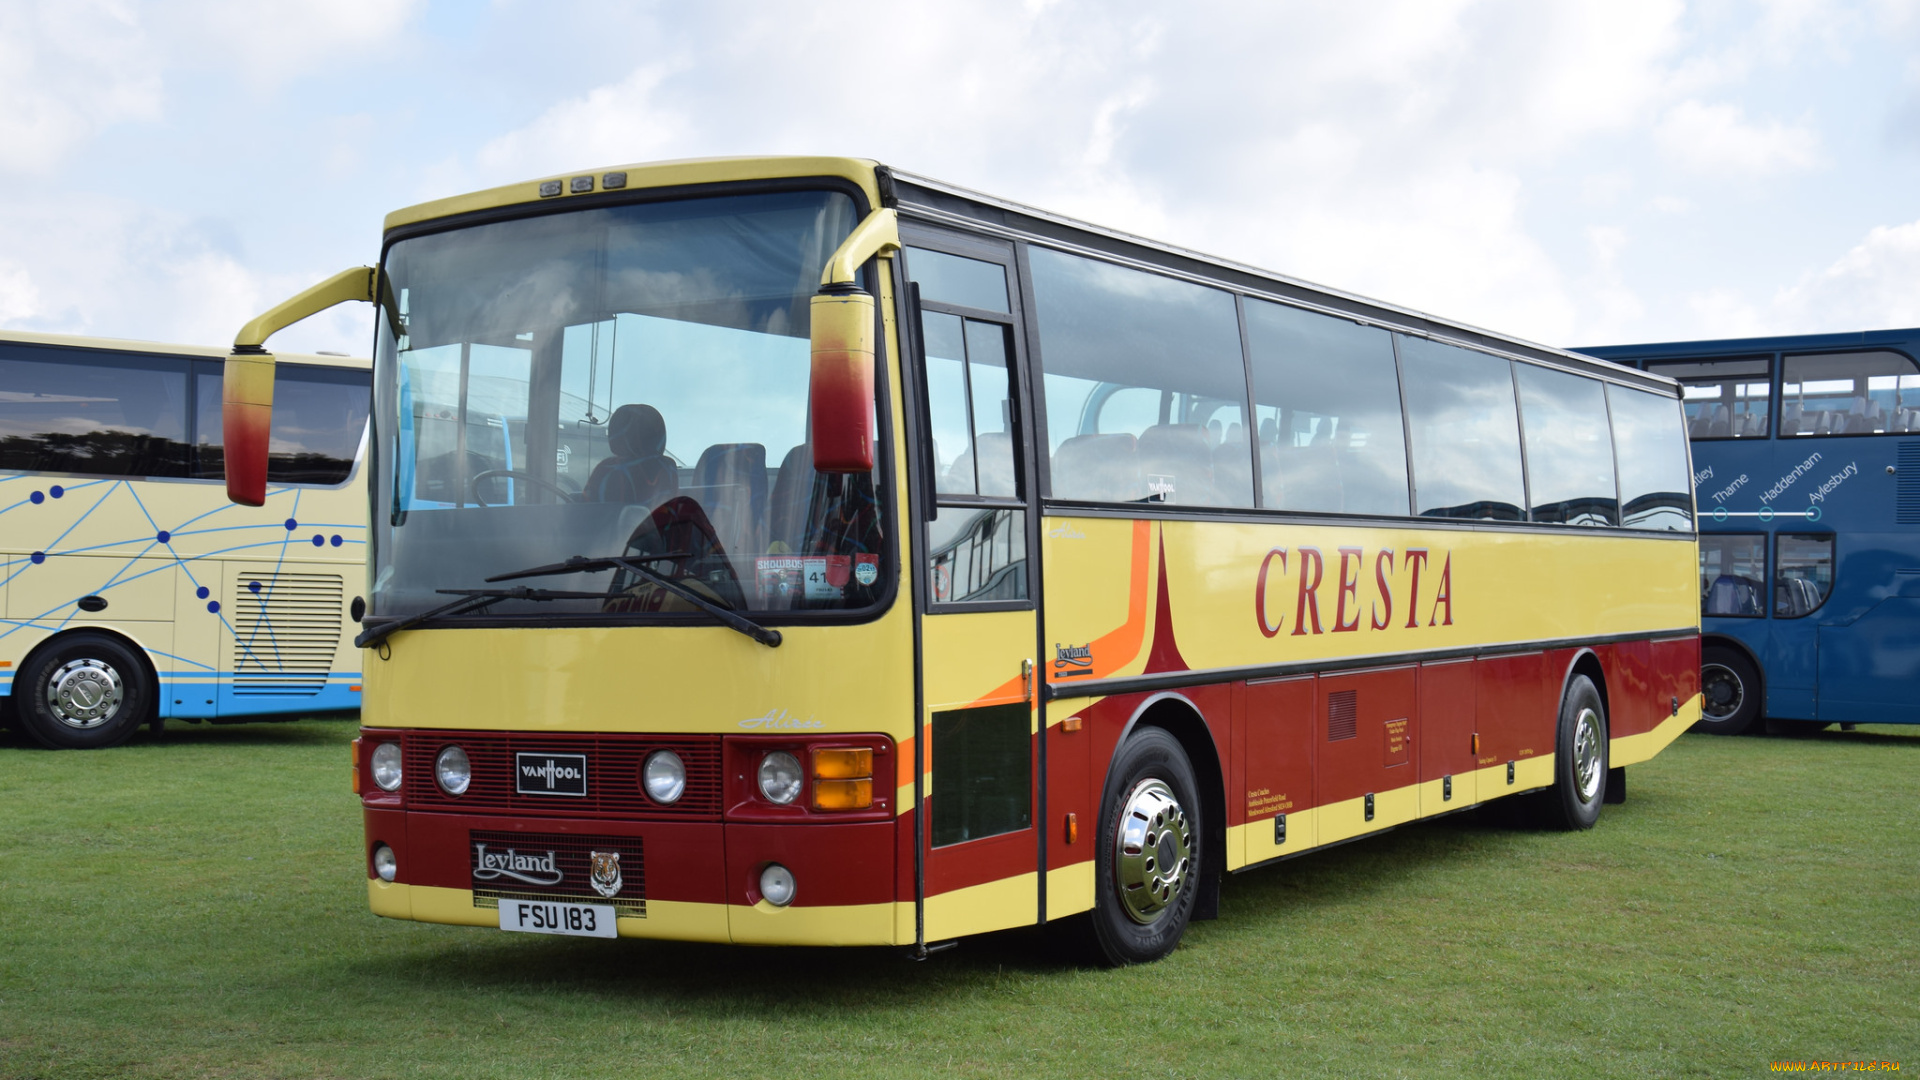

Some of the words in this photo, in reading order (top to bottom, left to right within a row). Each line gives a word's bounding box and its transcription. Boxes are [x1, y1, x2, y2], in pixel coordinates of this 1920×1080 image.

[1712, 473, 1749, 504] Thame
[1759, 452, 1822, 504] Haddenham
[1808, 461, 1858, 505] Aylesbury
[1255, 545, 1454, 638] CRESTA
[1054, 643, 1093, 668] Leyland
[473, 843, 563, 885] Leyland
[518, 904, 558, 929] FSU
[564, 907, 596, 931] 183
